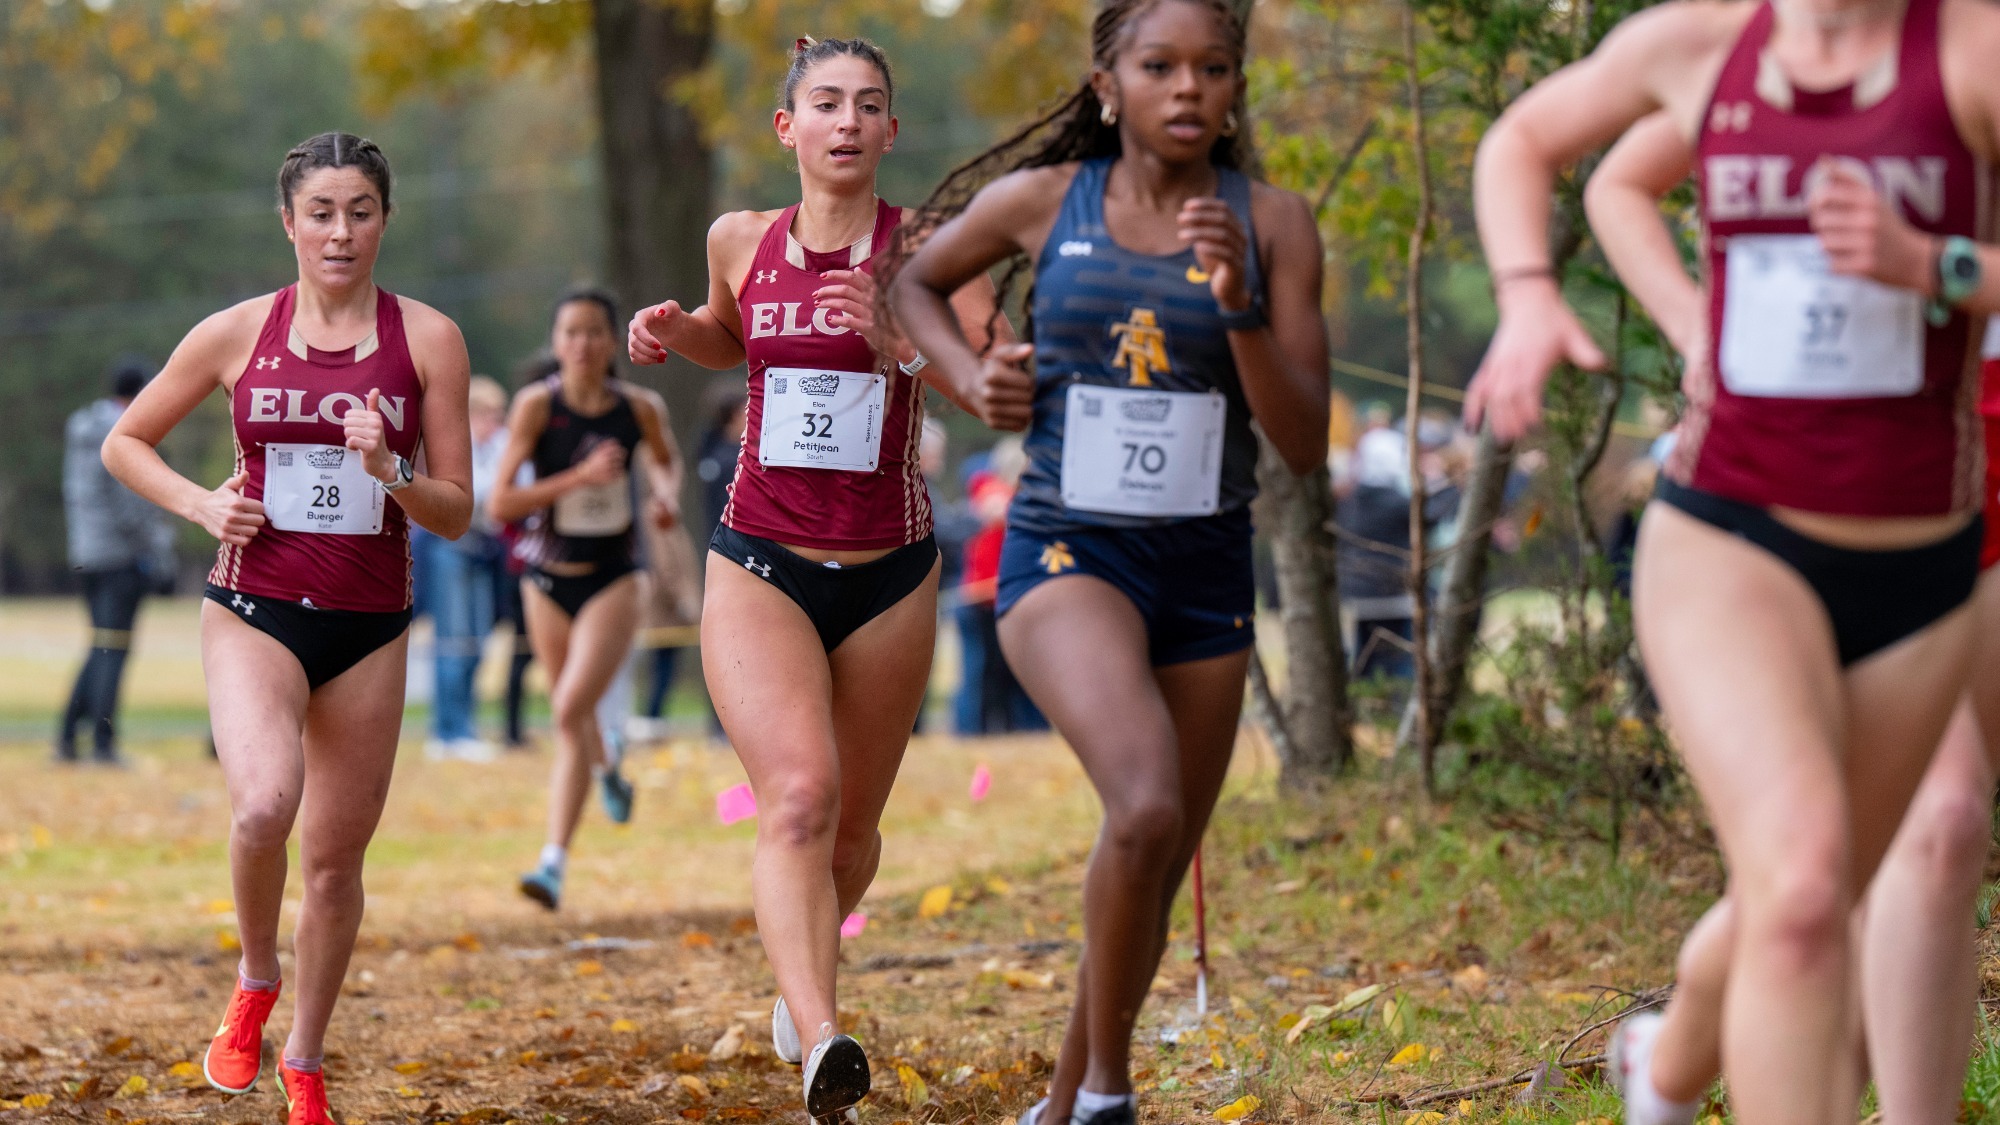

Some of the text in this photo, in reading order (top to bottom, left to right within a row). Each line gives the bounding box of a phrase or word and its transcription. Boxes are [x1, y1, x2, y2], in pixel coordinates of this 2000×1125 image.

[750, 302, 864, 339] ELO
[799, 377, 838, 388] CROSS
[801, 385, 837, 393] COUNTRY
[247, 388, 406, 432] ELON
[801, 412, 833, 439] 32
[1122, 442, 1167, 475] 70
[311, 485, 341, 508] 28
[307, 511, 344, 523] Buerger
